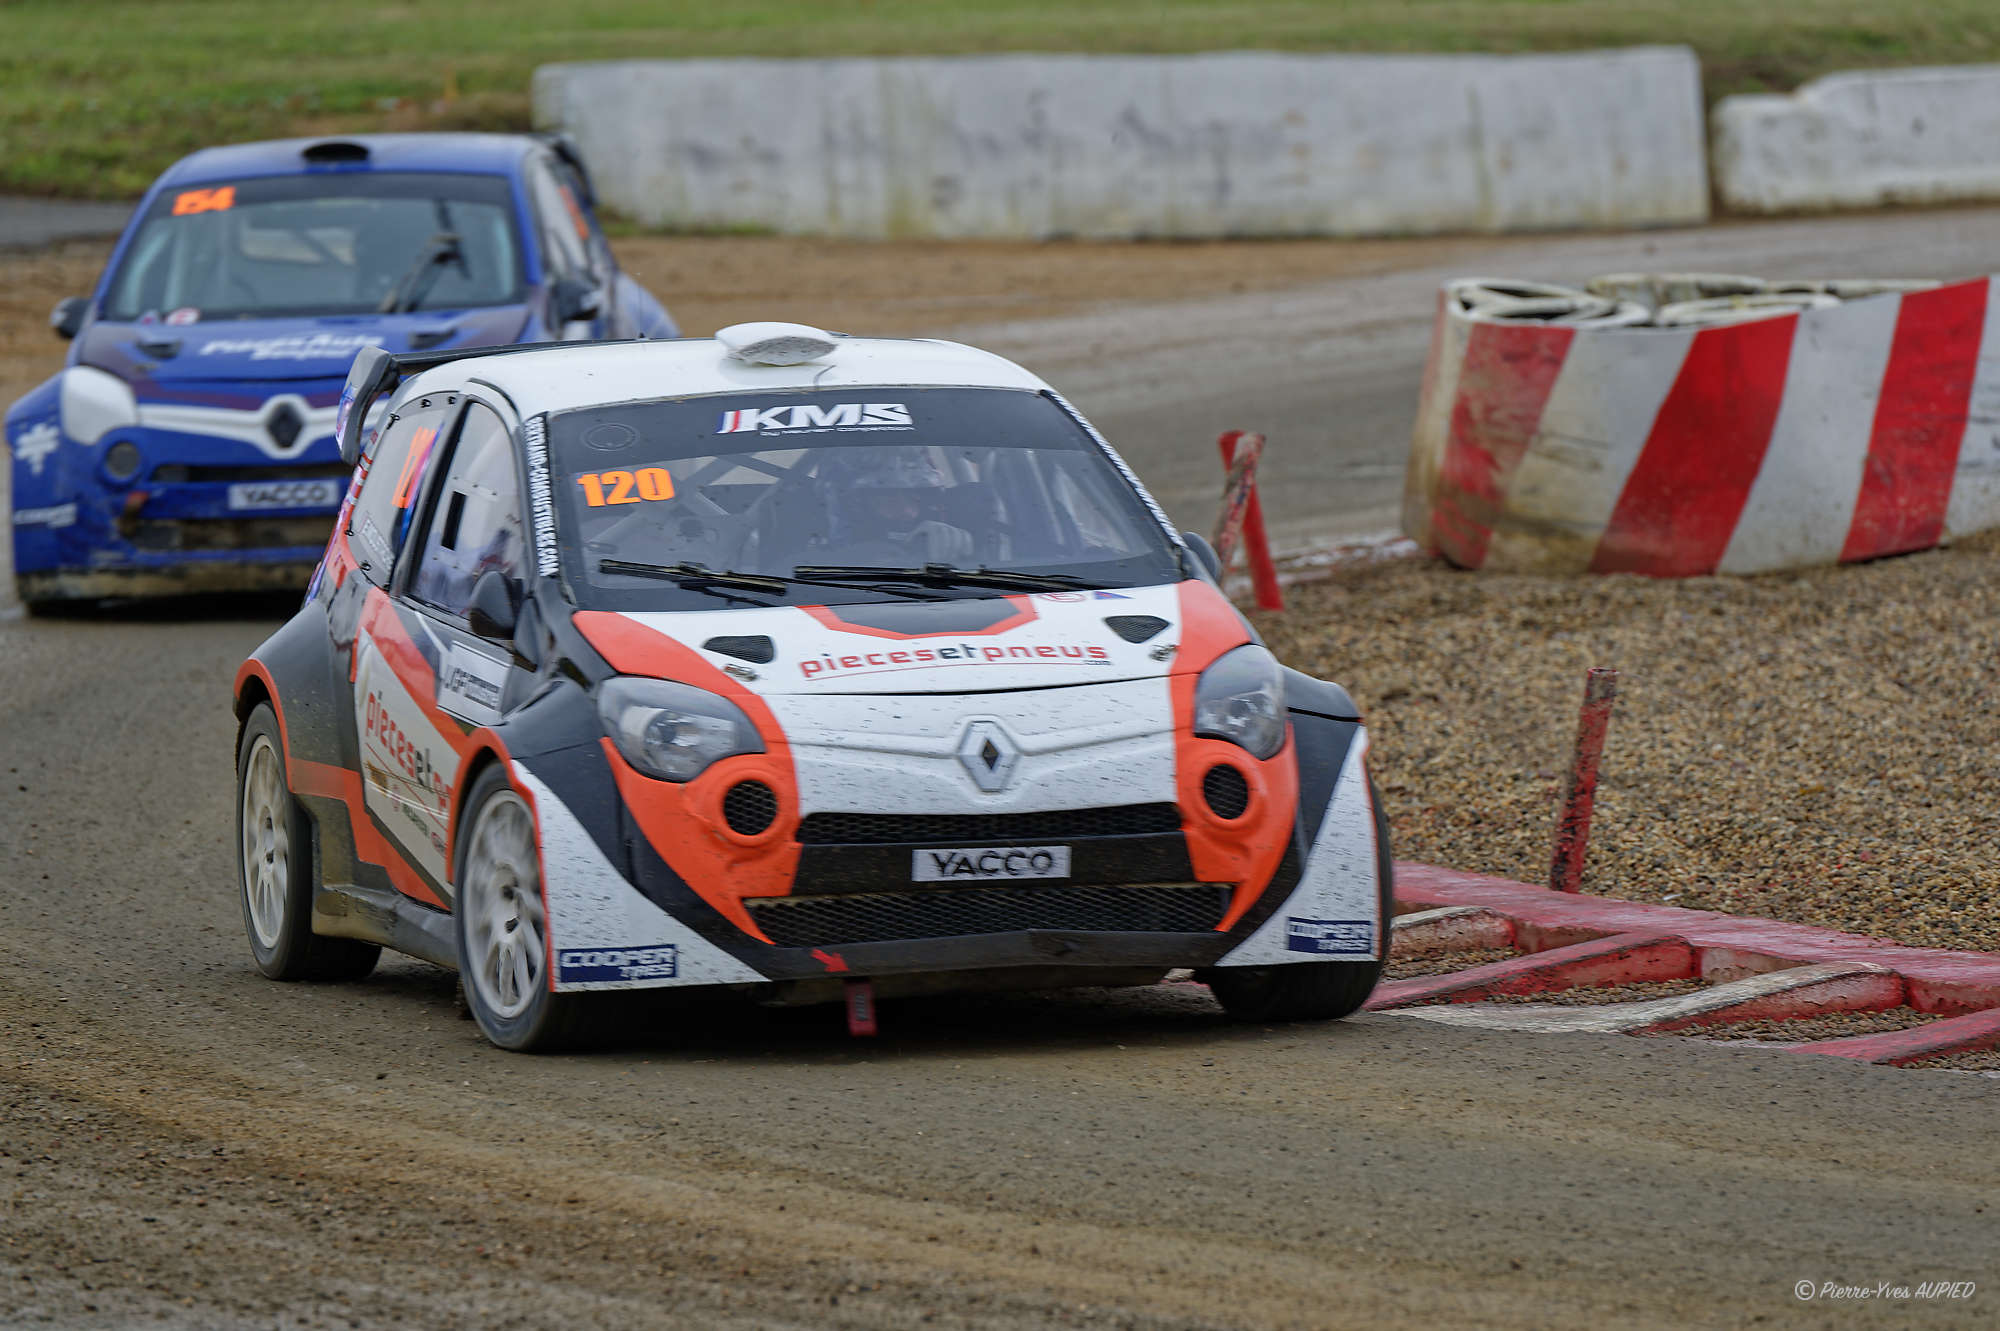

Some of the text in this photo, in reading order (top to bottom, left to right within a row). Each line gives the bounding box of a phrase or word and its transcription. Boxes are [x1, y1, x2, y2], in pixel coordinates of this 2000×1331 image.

[242, 484, 329, 504] YACCO
[577, 468, 675, 507] 120
[800, 643, 1108, 677] piecesetpneus
[928, 850, 1055, 877] YACCO
[561, 948, 675, 968] COOPER
